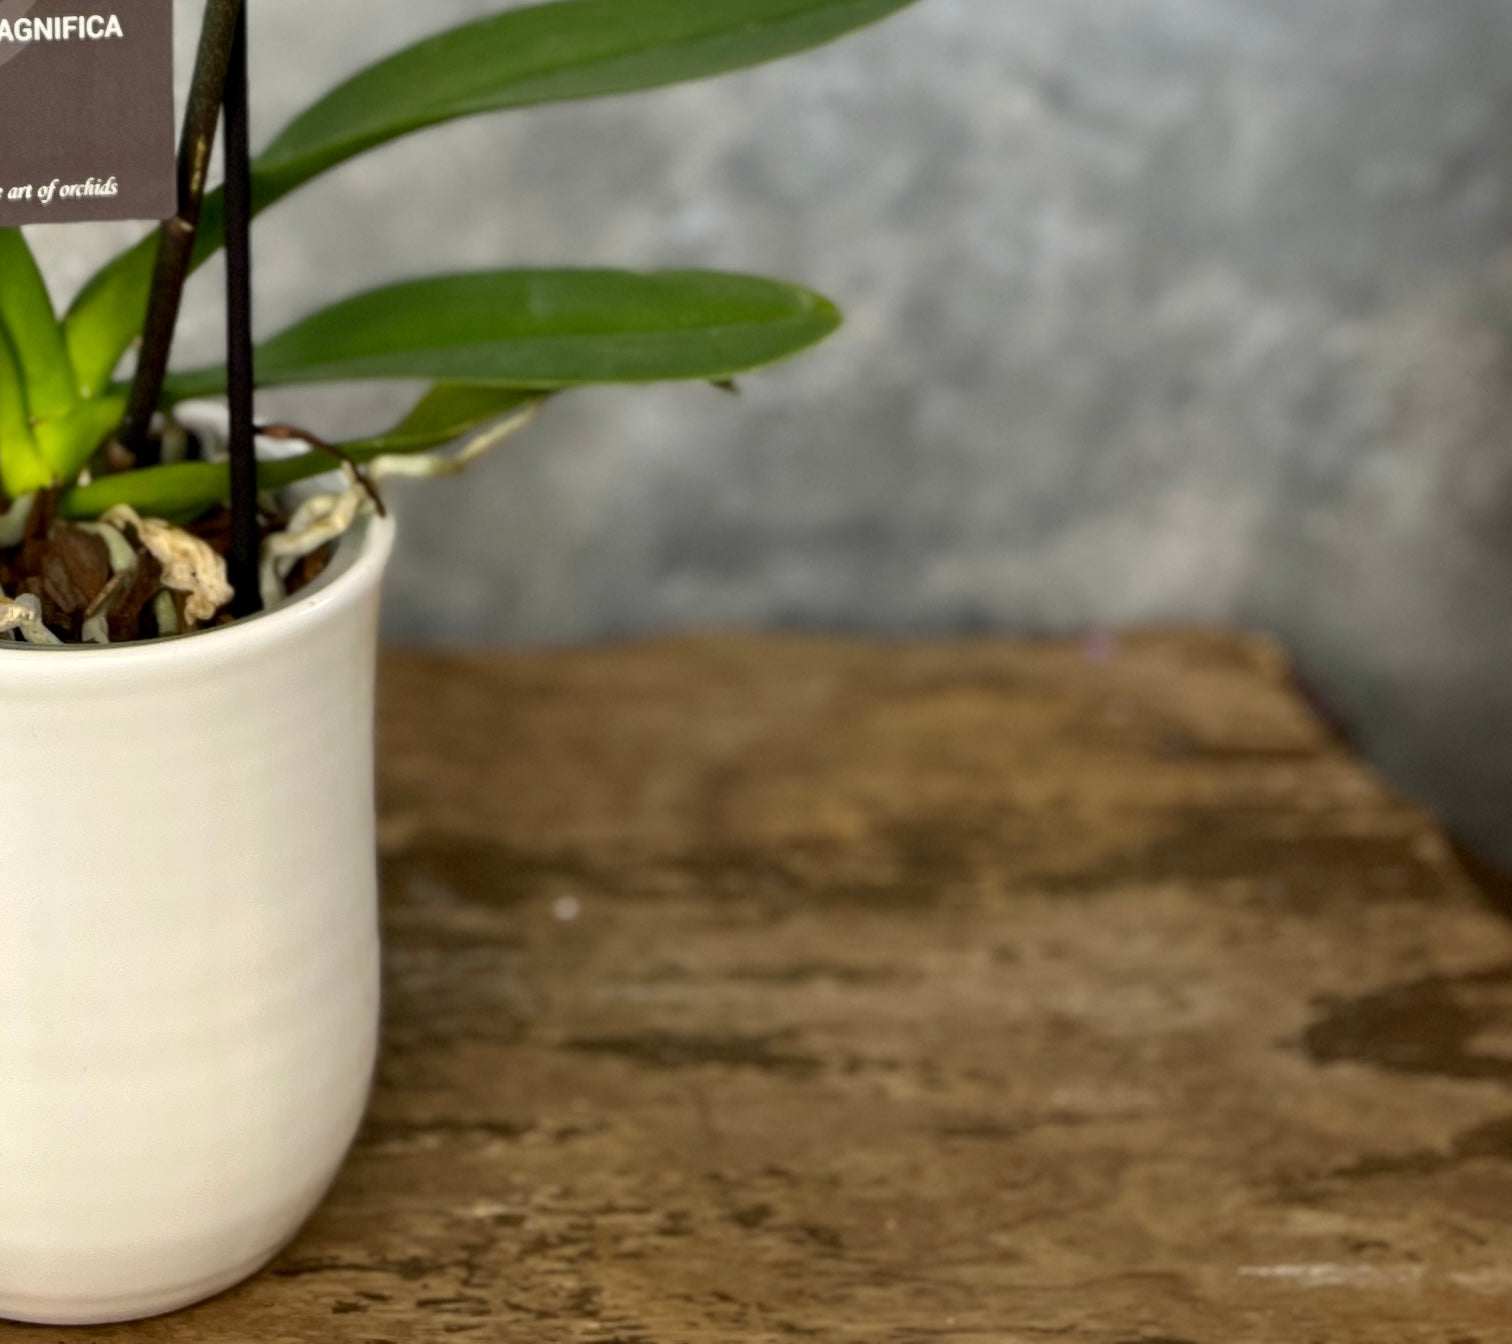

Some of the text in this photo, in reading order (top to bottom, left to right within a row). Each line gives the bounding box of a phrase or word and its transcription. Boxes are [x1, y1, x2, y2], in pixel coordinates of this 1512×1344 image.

[7, 184, 33, 200] art
[37, 178, 60, 204] of
[59, 176, 119, 198] orchids
